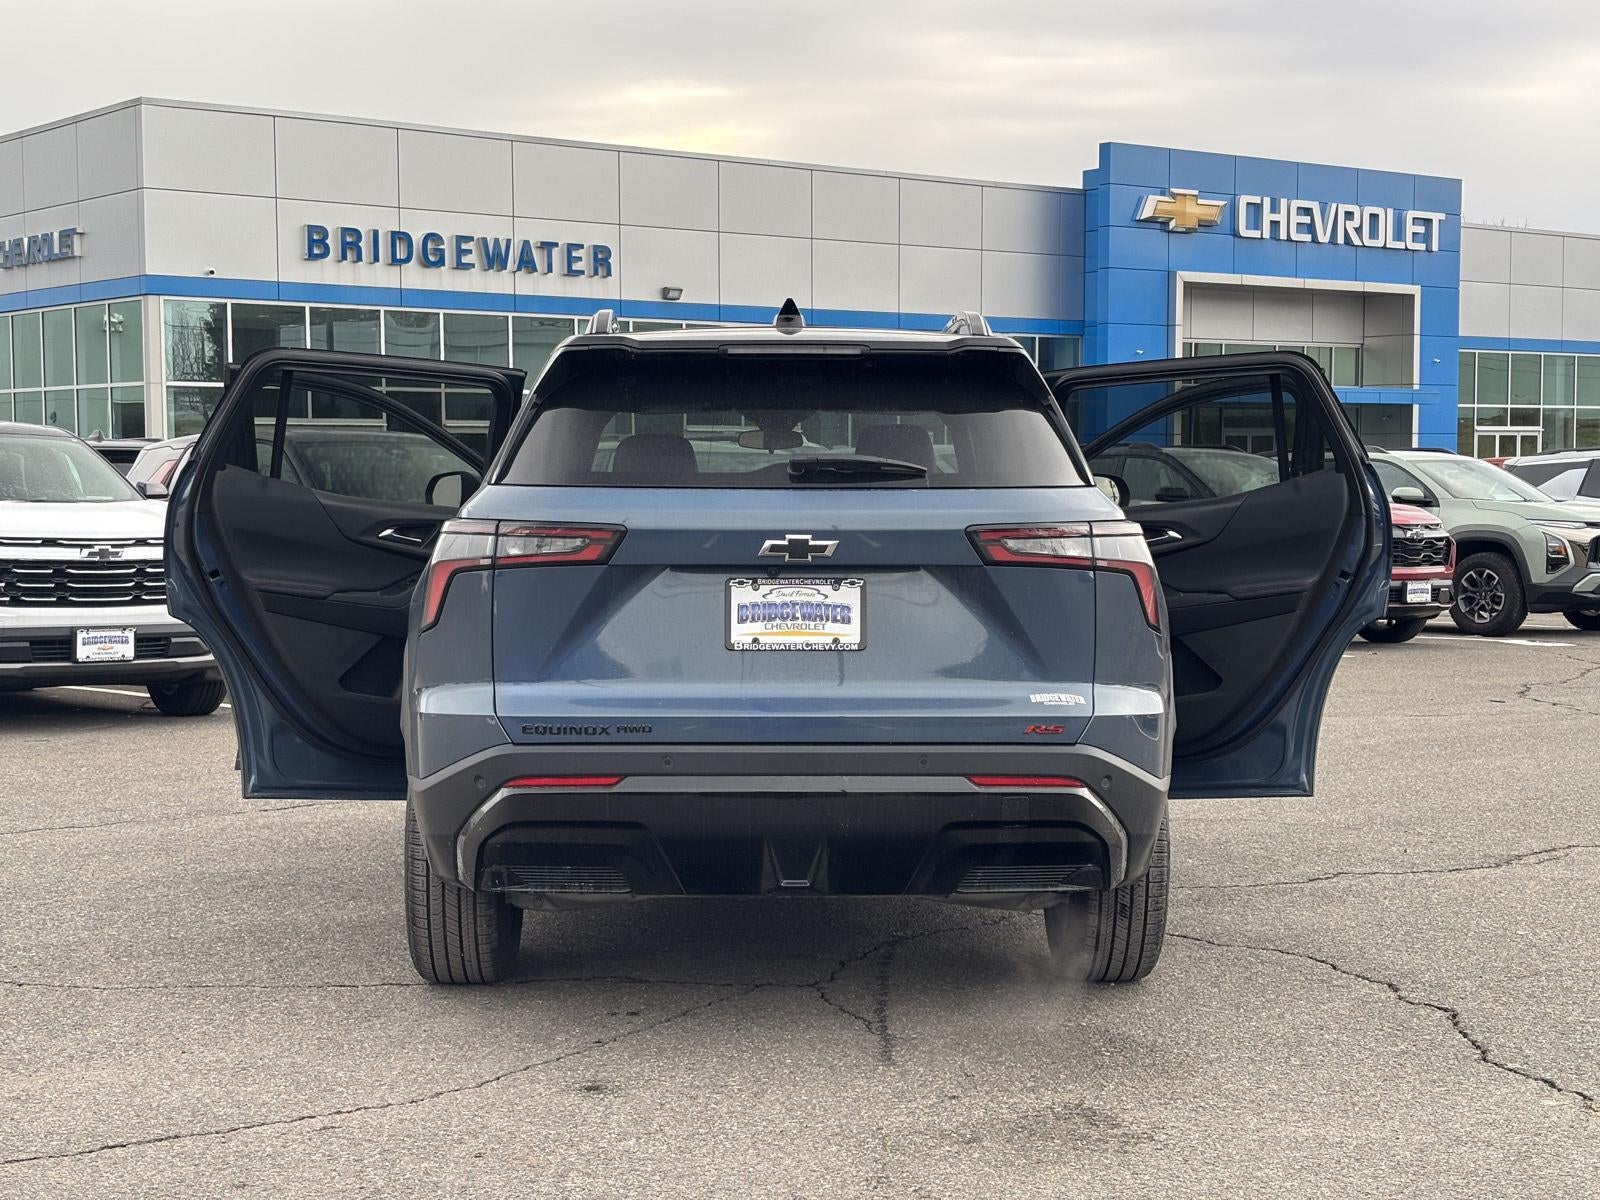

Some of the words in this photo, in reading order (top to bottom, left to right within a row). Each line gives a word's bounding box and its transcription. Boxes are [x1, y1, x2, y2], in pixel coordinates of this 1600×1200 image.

[1237, 195, 1446, 252] CHEVROLET
[304, 224, 613, 278] BRIDGEWATER
[738, 600, 852, 624] BRIDGEWATER
[764, 623, 826, 631] CHEVROLET
[82, 635, 129, 646] BRIDGEWATER
[1029, 693, 1087, 704] BRIDGEWATER
[522, 724, 611, 735] EQUINOX
[617, 725, 652, 733] AWD
[1024, 725, 1065, 734] RS
